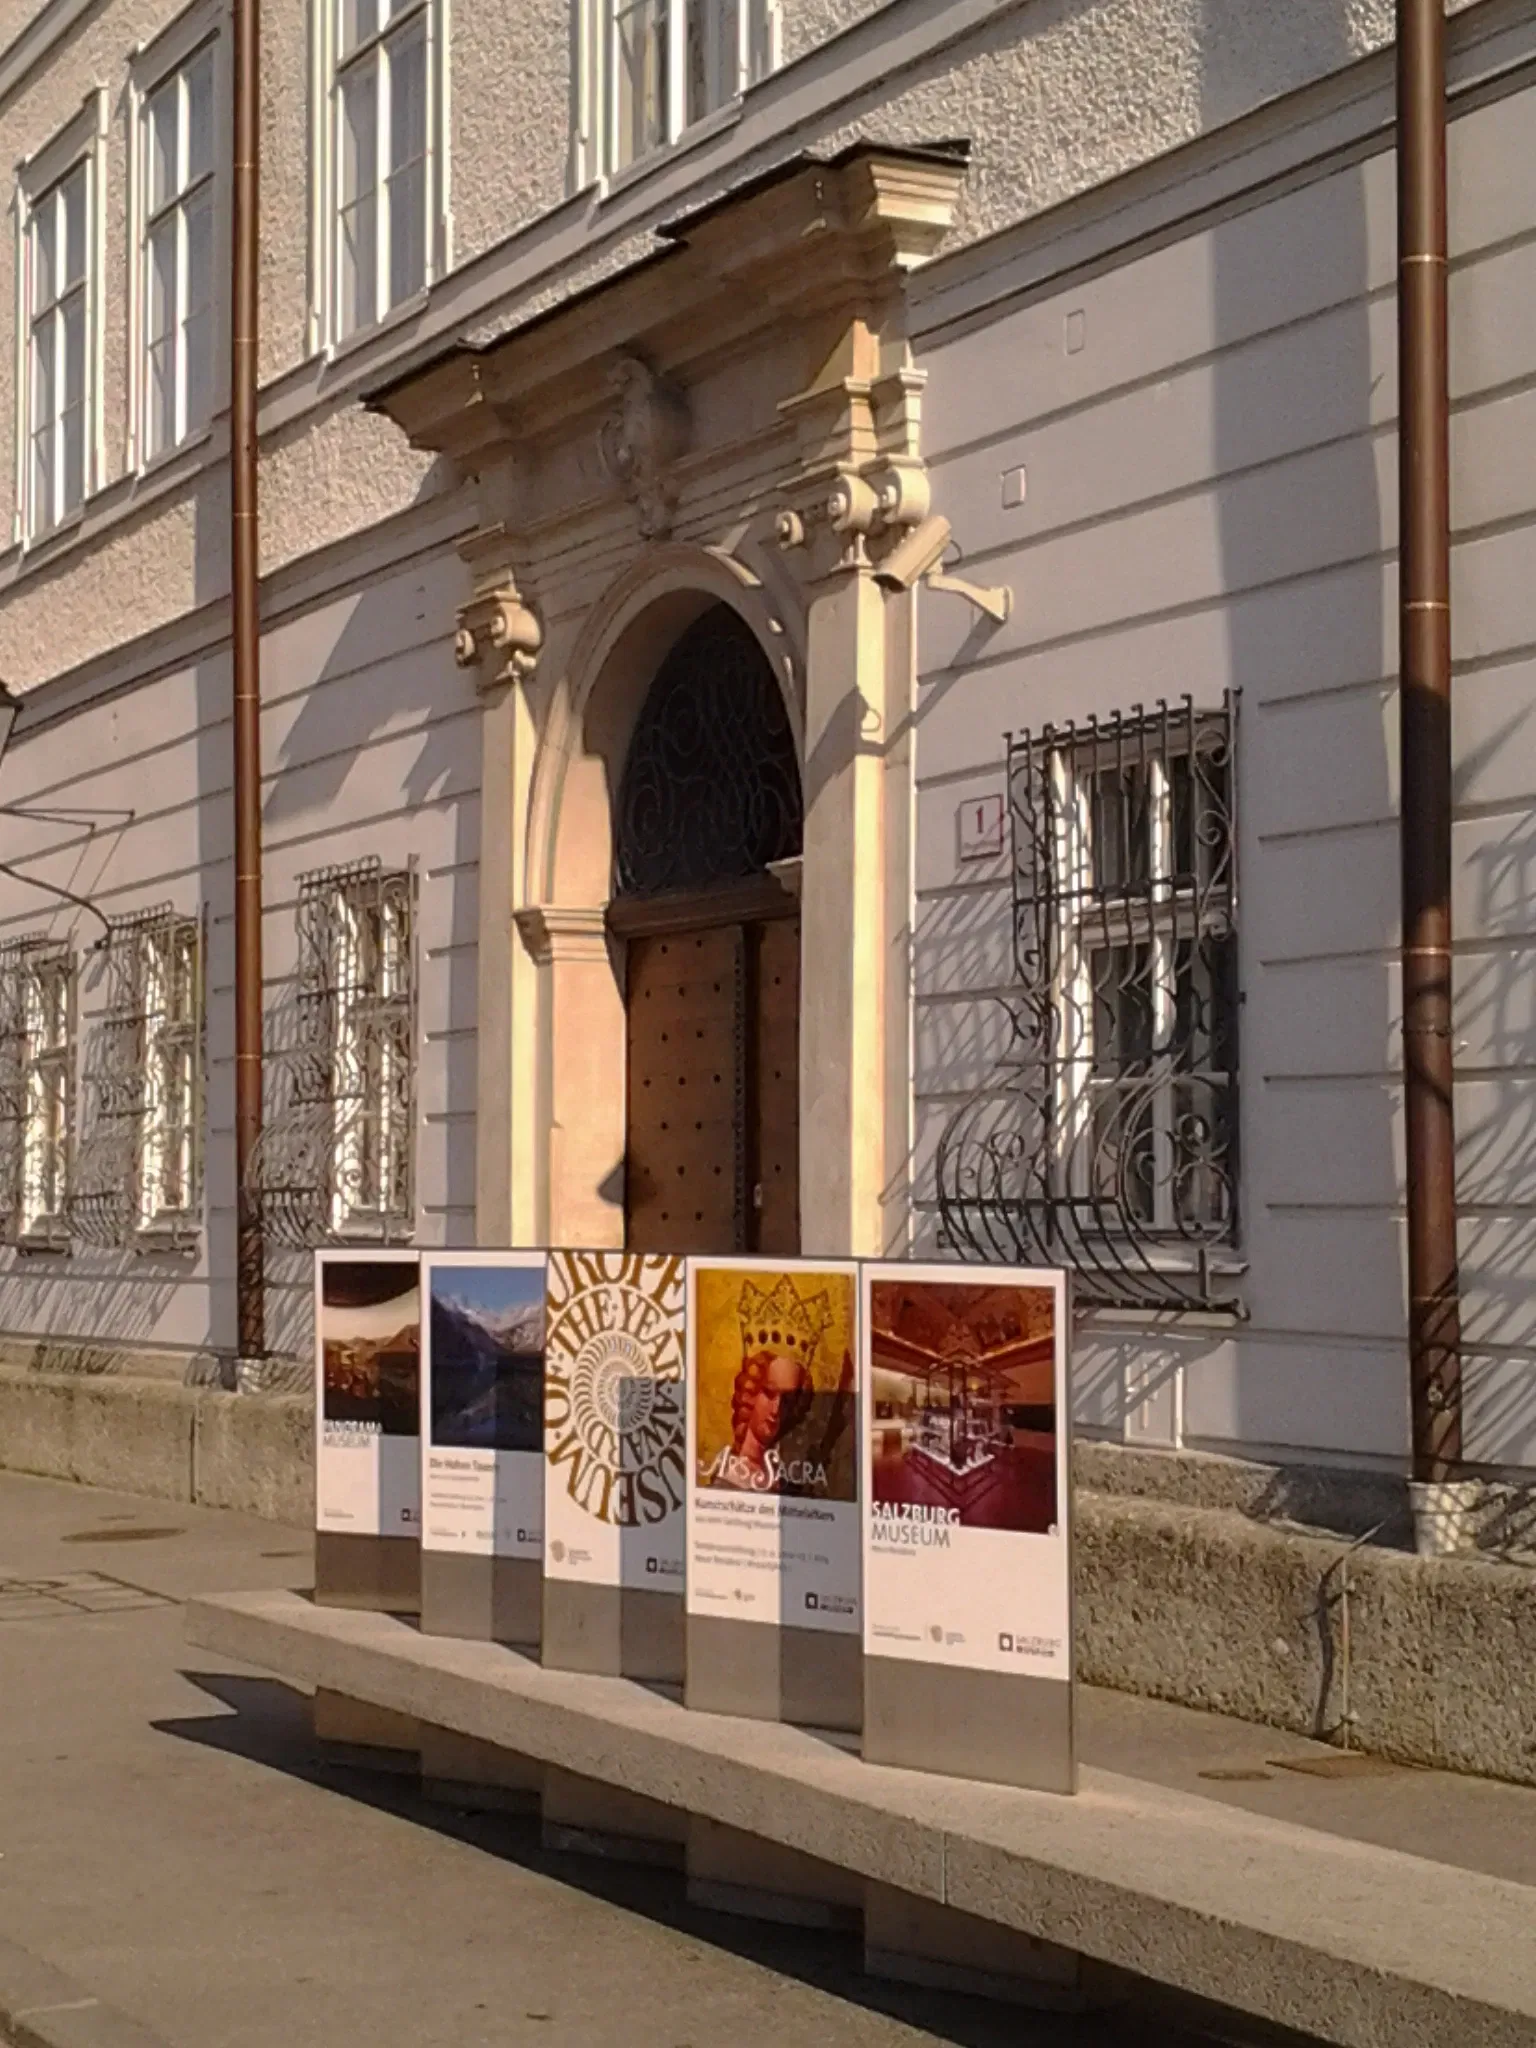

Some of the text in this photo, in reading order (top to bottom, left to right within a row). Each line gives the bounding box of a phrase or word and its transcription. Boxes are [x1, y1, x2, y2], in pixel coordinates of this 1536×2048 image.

[975, 804, 985, 834] 1
[546, 1287, 616, 1361] THE
[618, 1287, 680, 1390] YEAR
[587, 1384, 680, 1470] AWARD
[871, 1501, 961, 1528] SALZBURG
[871, 1523, 951, 1549] MUSEUM
